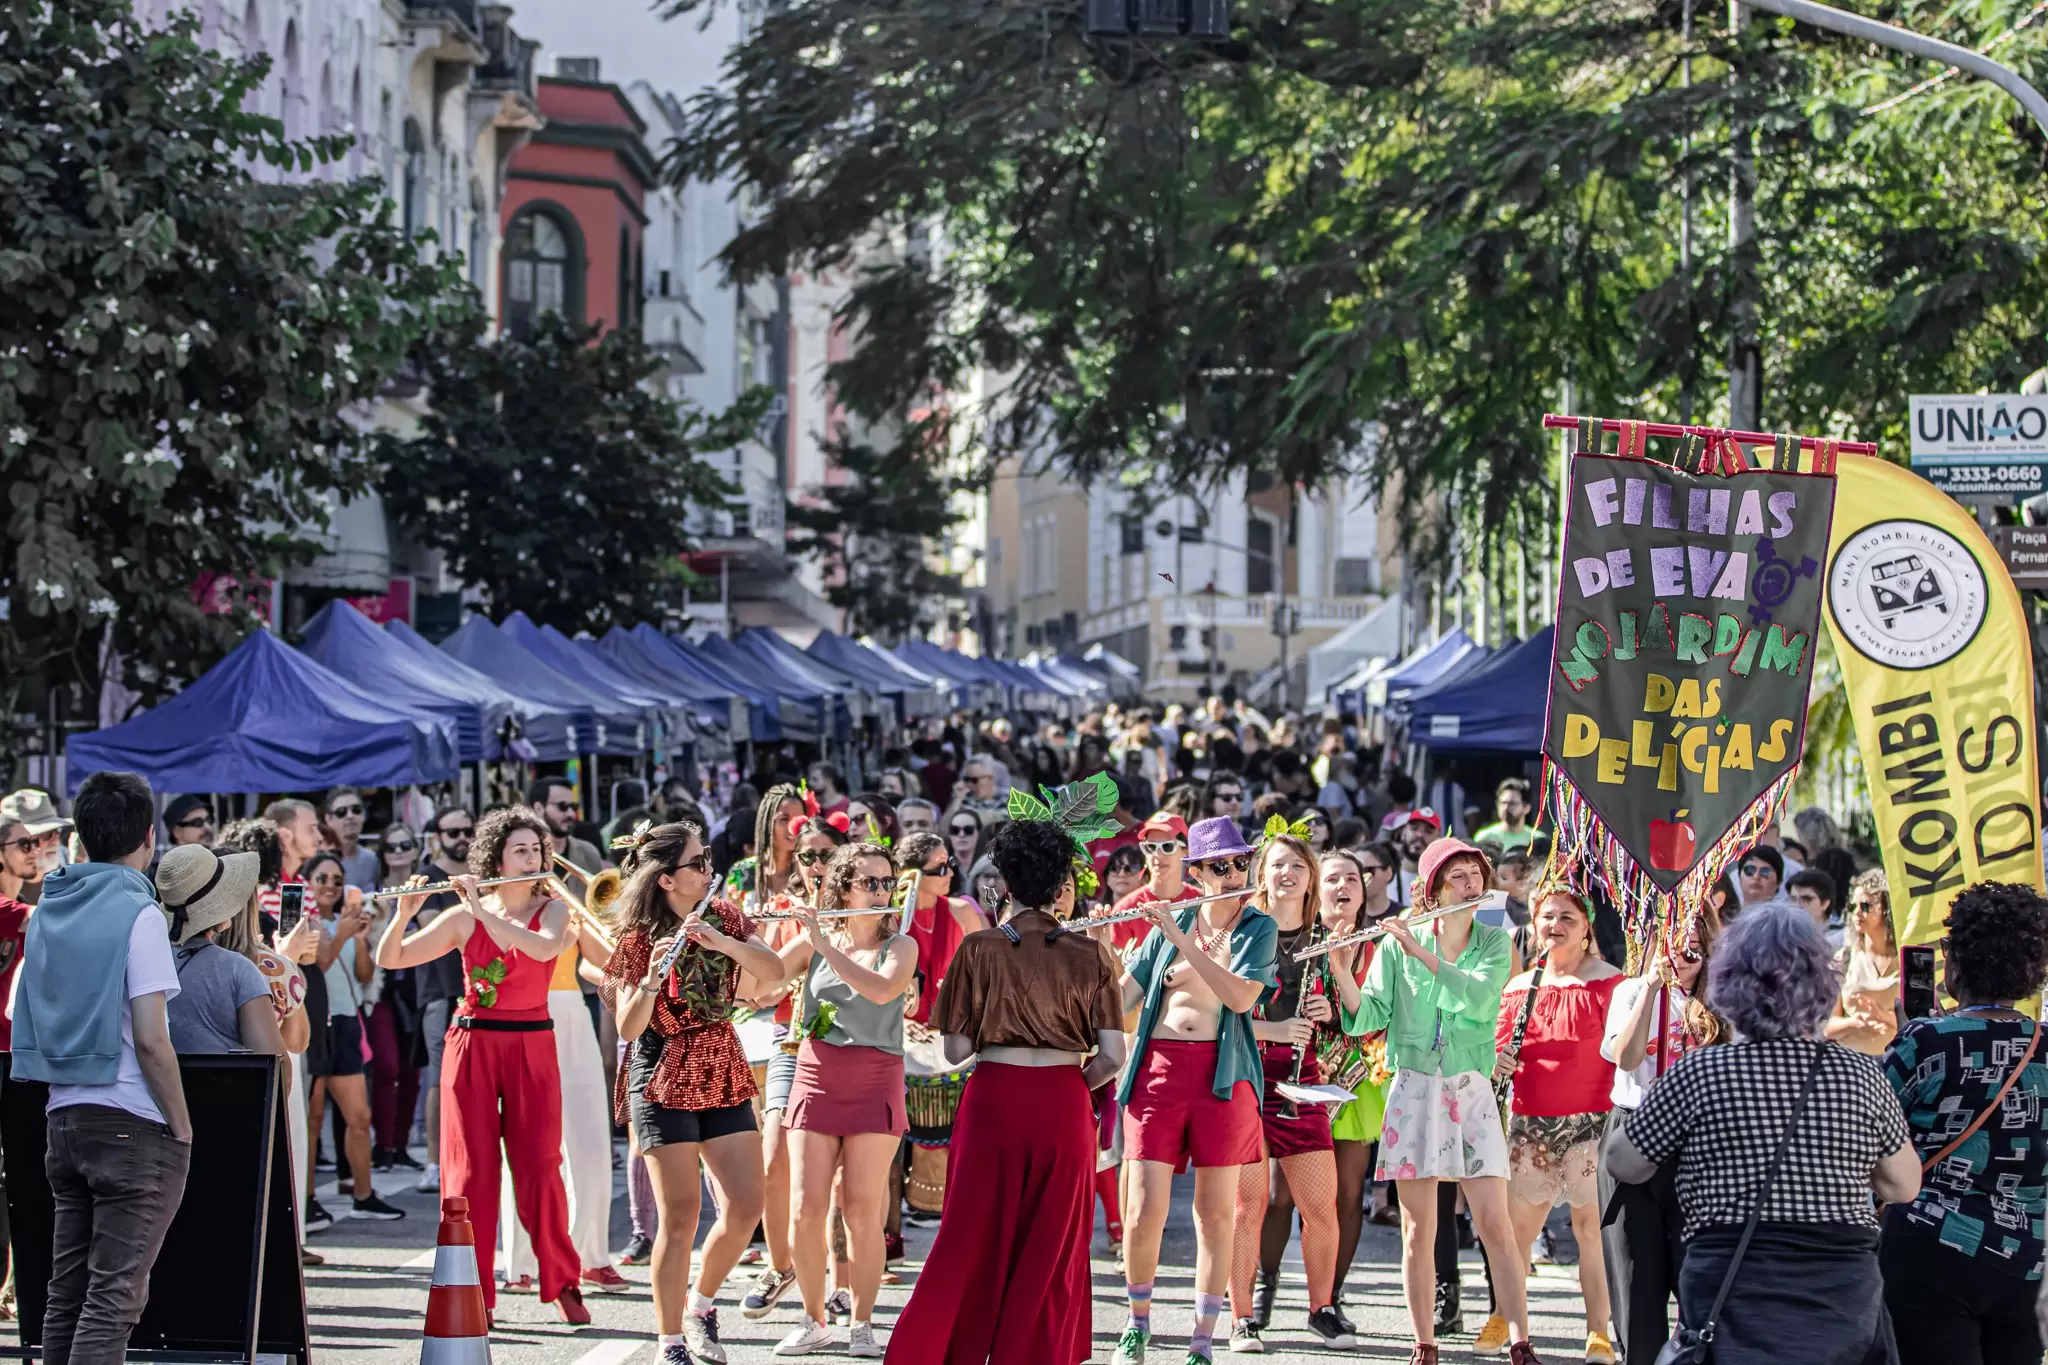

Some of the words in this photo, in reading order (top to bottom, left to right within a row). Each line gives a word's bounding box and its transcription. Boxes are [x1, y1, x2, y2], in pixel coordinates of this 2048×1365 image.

[1950, 466, 2042, 481] 3333-0660
[1584, 477, 1796, 539] FILHAS
[1841, 554, 1861, 588] MINI
[1861, 532, 1910, 552] KOMBI
[1920, 535, 1954, 558] KIDS
[2012, 531, 2047, 547] Praça
[1572, 548, 1635, 598] DE
[1650, 545, 1748, 601] EVA
[1557, 619, 1612, 694] NO
[1614, 602, 1809, 678] JARDIM
[1854, 624, 1925, 657] KOMBIZINHA
[1932, 643, 1946, 653] DA
[1643, 673, 1721, 718] DAS
[1562, 713, 1794, 793] DELÍCIAS
[1872, 690, 1966, 898] KOMBI
